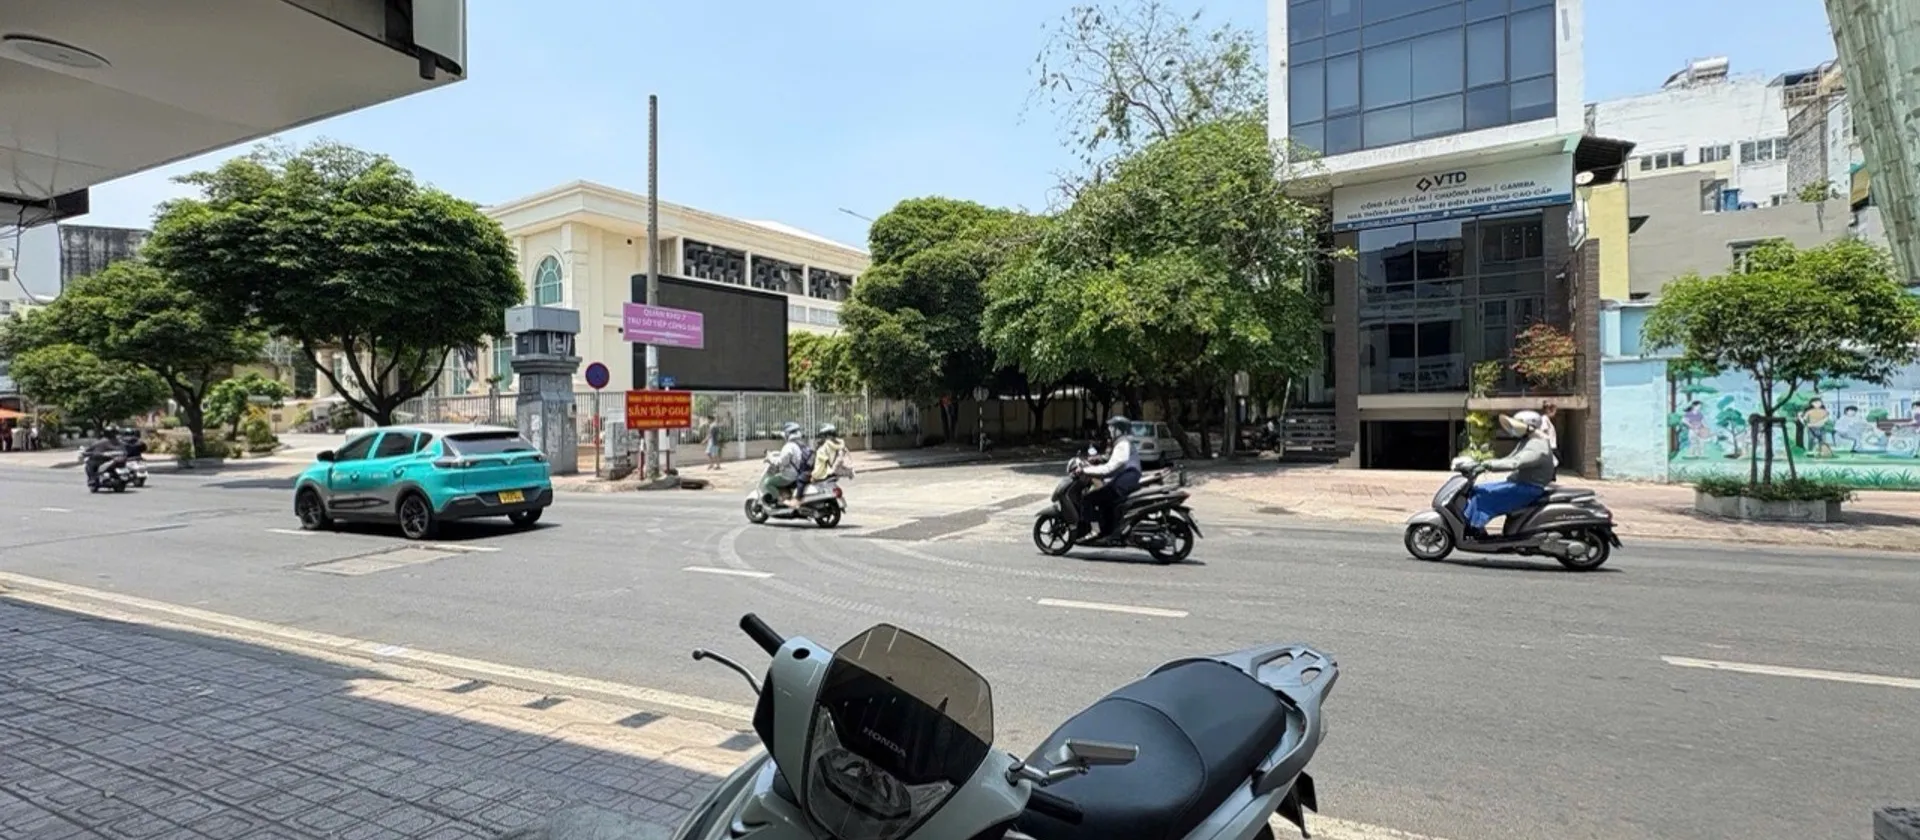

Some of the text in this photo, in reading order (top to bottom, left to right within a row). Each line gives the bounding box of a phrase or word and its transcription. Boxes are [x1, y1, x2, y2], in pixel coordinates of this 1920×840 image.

[1434, 171, 1467, 186] VTD
[1360, 202, 1383, 210] CÔNG
[1434, 190, 1469, 199] CHUÔNG
[1500, 181, 1535, 190] CAMERA
[1364, 210, 1389, 218] THÔNG
[1512, 190, 1532, 199] CAO
[863, 726, 906, 758] HONDA
